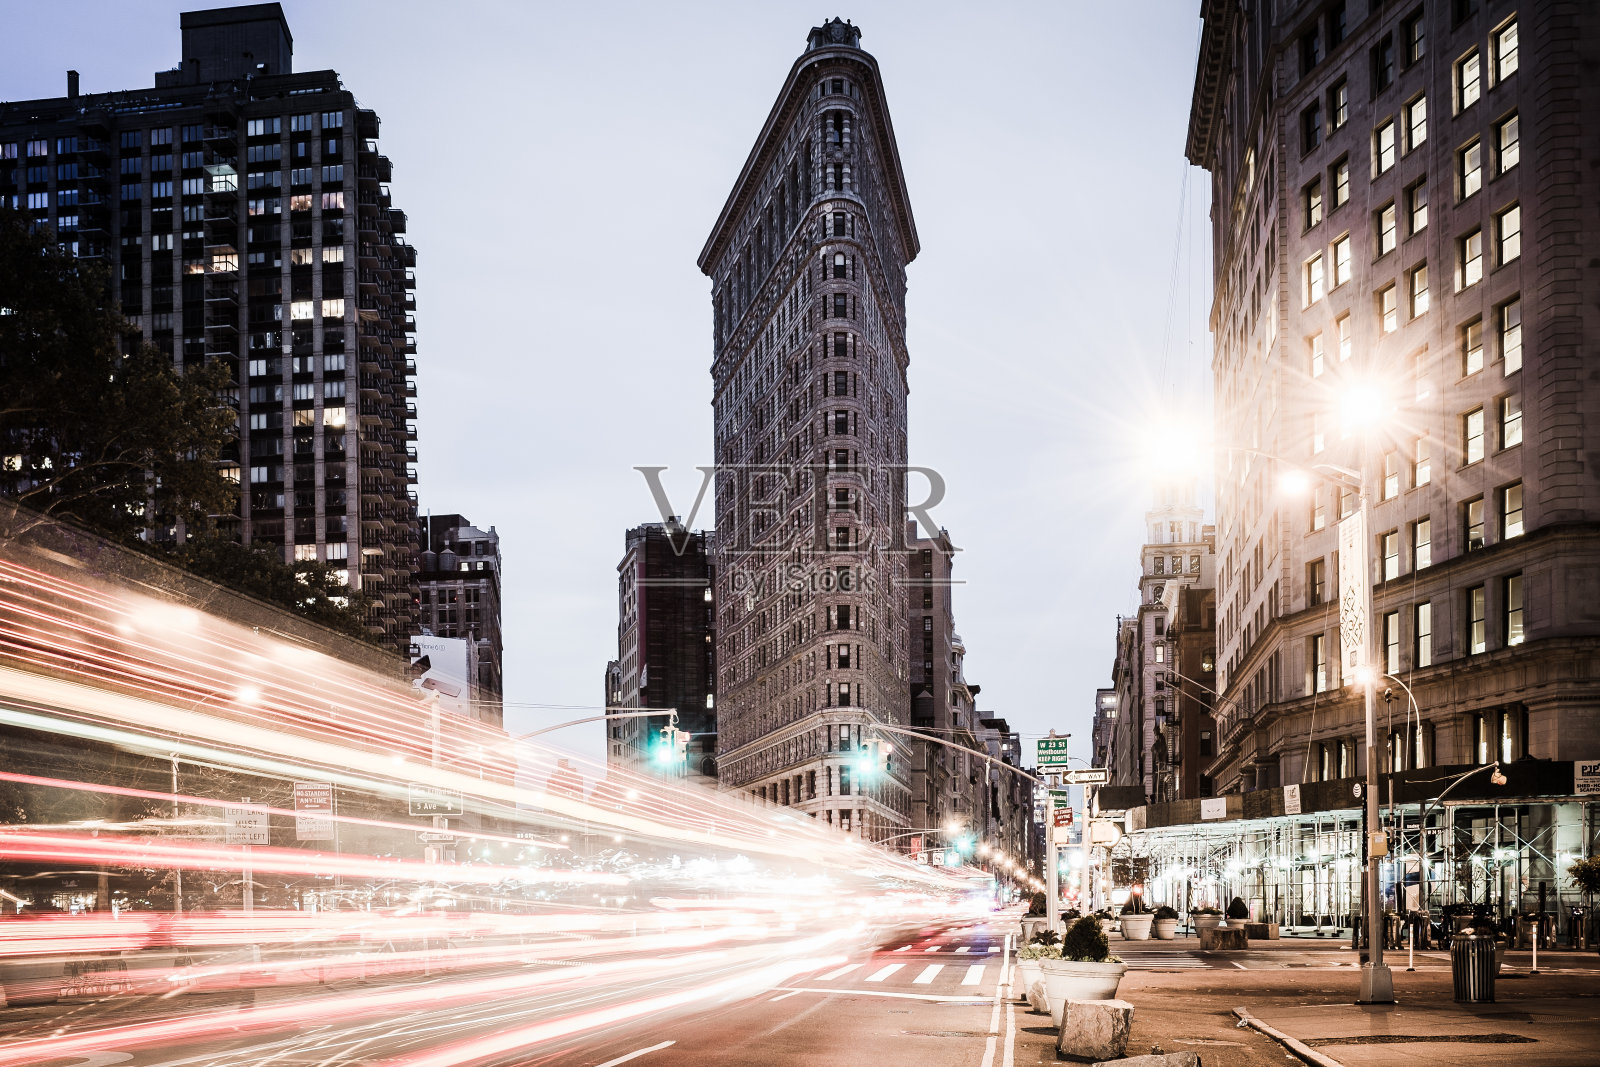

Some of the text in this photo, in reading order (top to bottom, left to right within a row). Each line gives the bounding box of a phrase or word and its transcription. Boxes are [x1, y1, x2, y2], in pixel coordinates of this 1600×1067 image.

[416, 802, 437, 810] 5 Ave
[227, 808, 243, 816] LEFT
[235, 820, 257, 828] MUST
[228, 832, 246, 840] TURN
